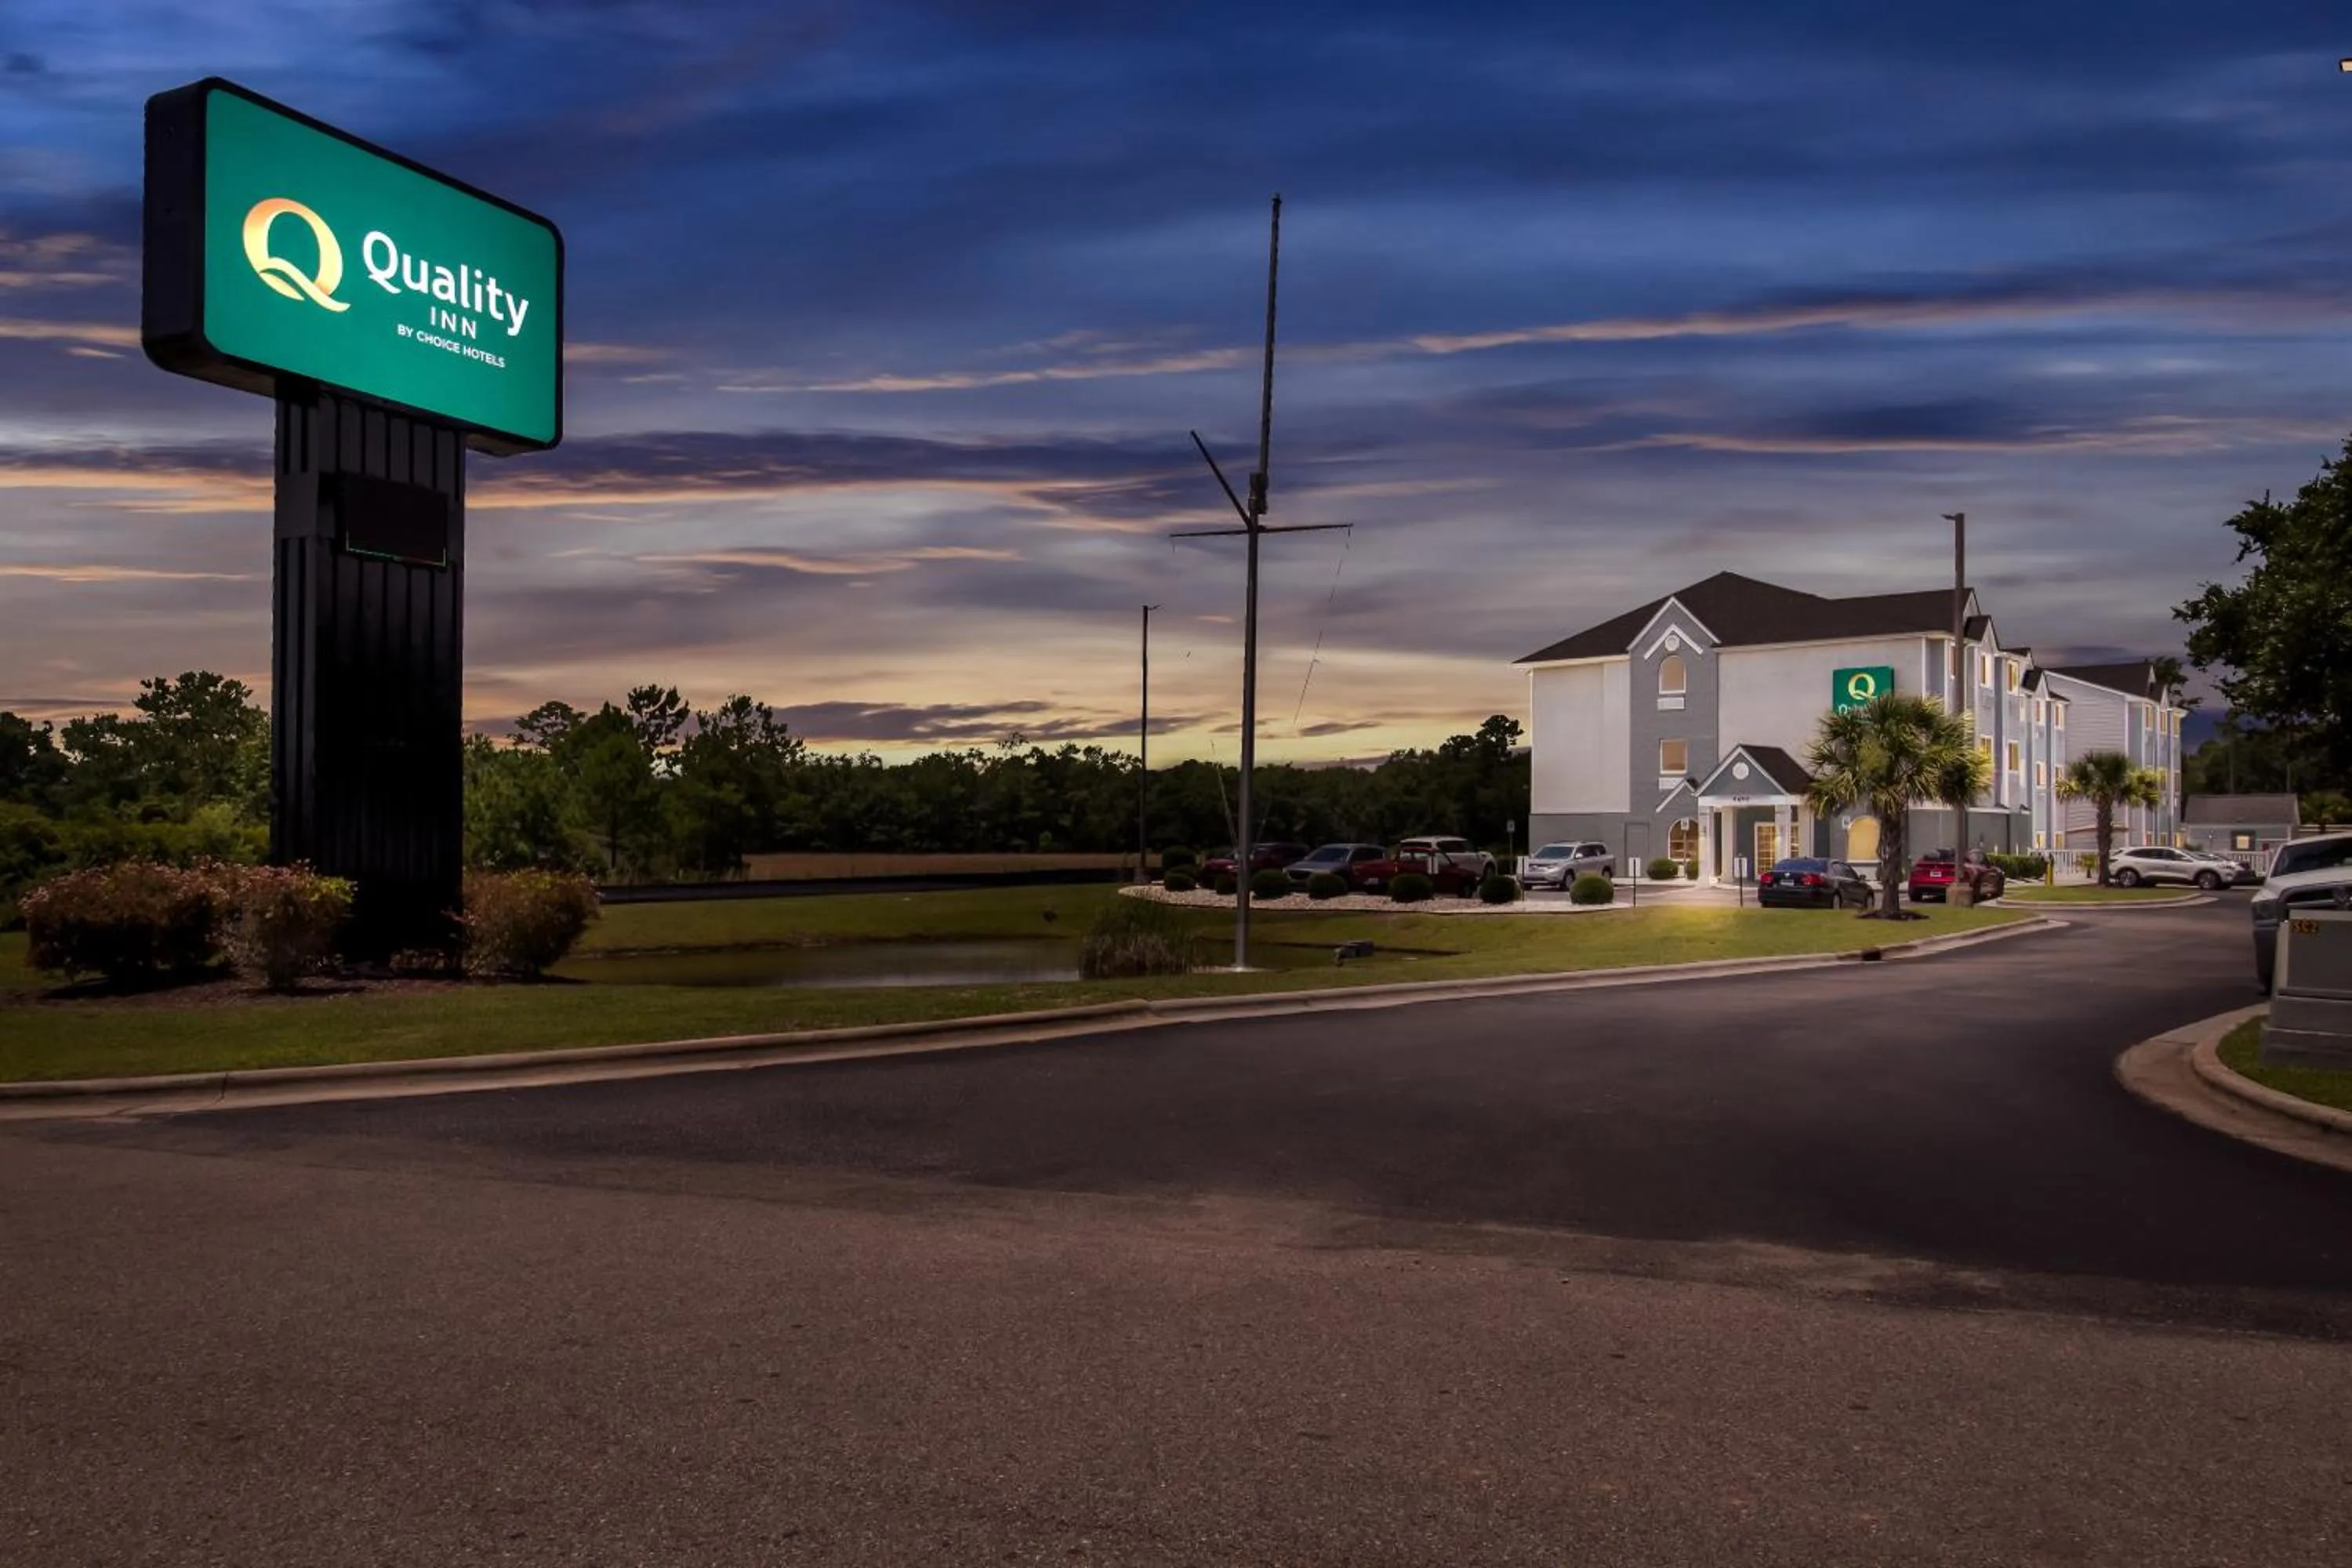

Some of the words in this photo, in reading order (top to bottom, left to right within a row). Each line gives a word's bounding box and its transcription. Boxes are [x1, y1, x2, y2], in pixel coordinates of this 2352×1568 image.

[243, 198, 350, 312] Q
[362, 230, 529, 336] Quality
[430, 306, 477, 339] INN
[397, 324, 413, 338] BY
[416, 330, 460, 354] CHOICE
[463, 345, 506, 368] HOTELS
[1849, 673, 1878, 700] Q
